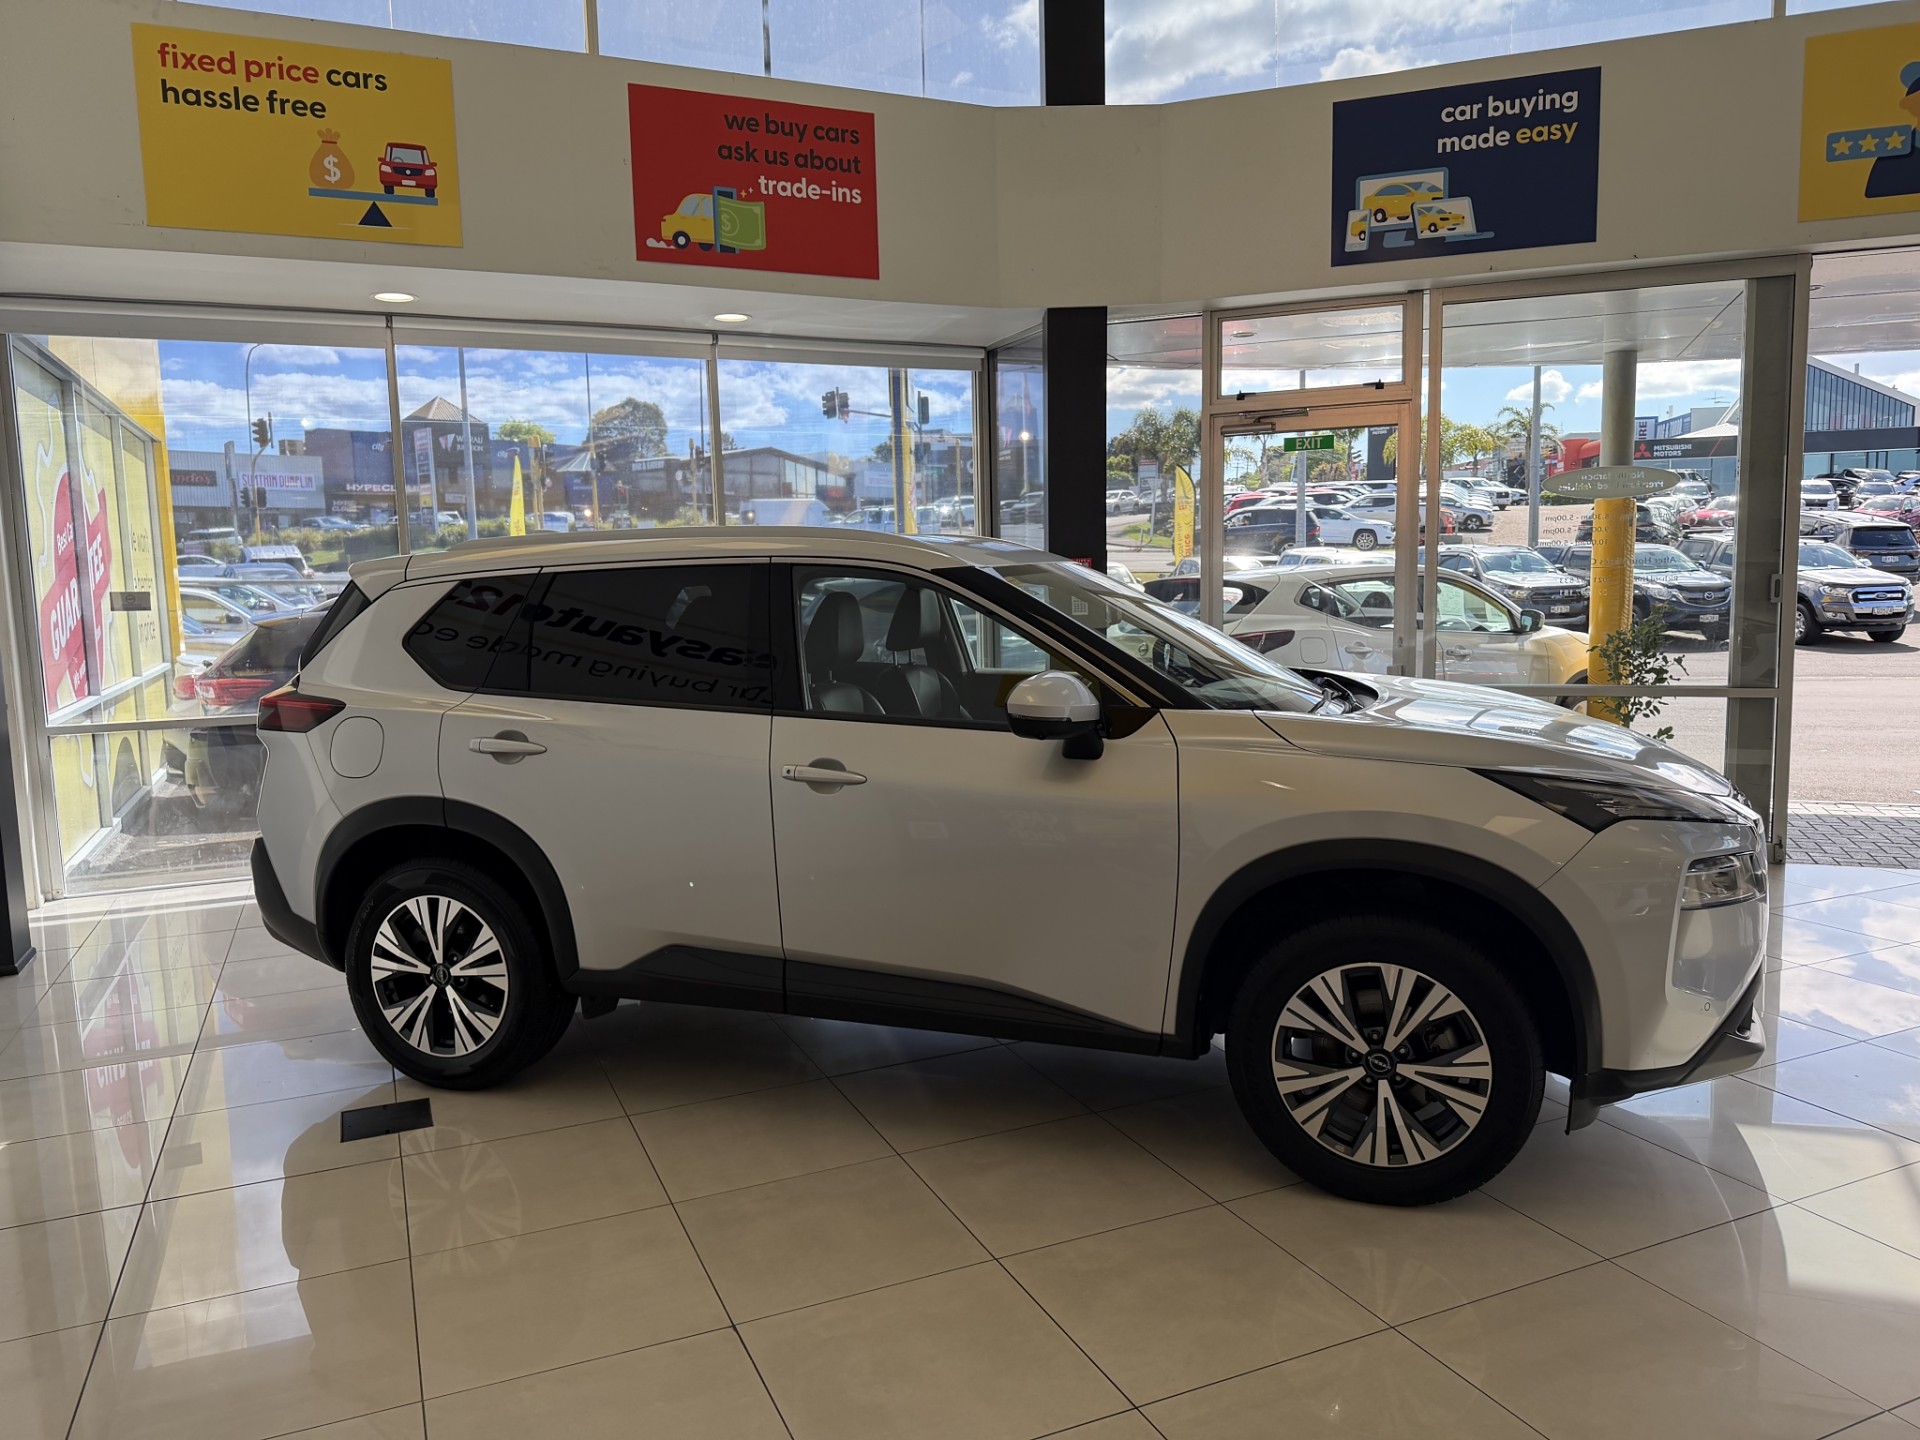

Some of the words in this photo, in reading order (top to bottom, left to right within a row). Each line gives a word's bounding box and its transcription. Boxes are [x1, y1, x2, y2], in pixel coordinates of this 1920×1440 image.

[157, 42, 237, 76] fixed
[244, 56, 320, 84] price
[325, 67, 388, 92] cars
[160, 78, 260, 113] hassle
[265, 89, 327, 119] free
[1440, 101, 1483, 123] car
[1487, 88, 1580, 119] buying
[723, 113, 760, 133] we
[764, 113, 809, 144] buy
[812, 123, 861, 145] cars
[1436, 125, 1511, 154] made
[1515, 121, 1580, 145] easy
[717, 140, 759, 164] ask
[764, 151, 790, 167] us
[793, 148, 862, 175] about
[757, 174, 863, 205] trade-ins
[1295, 436, 1323, 450] EXIT
[1638, 420, 1648, 440] IRE
[1653, 443, 1692, 451] MITSUBISHI
